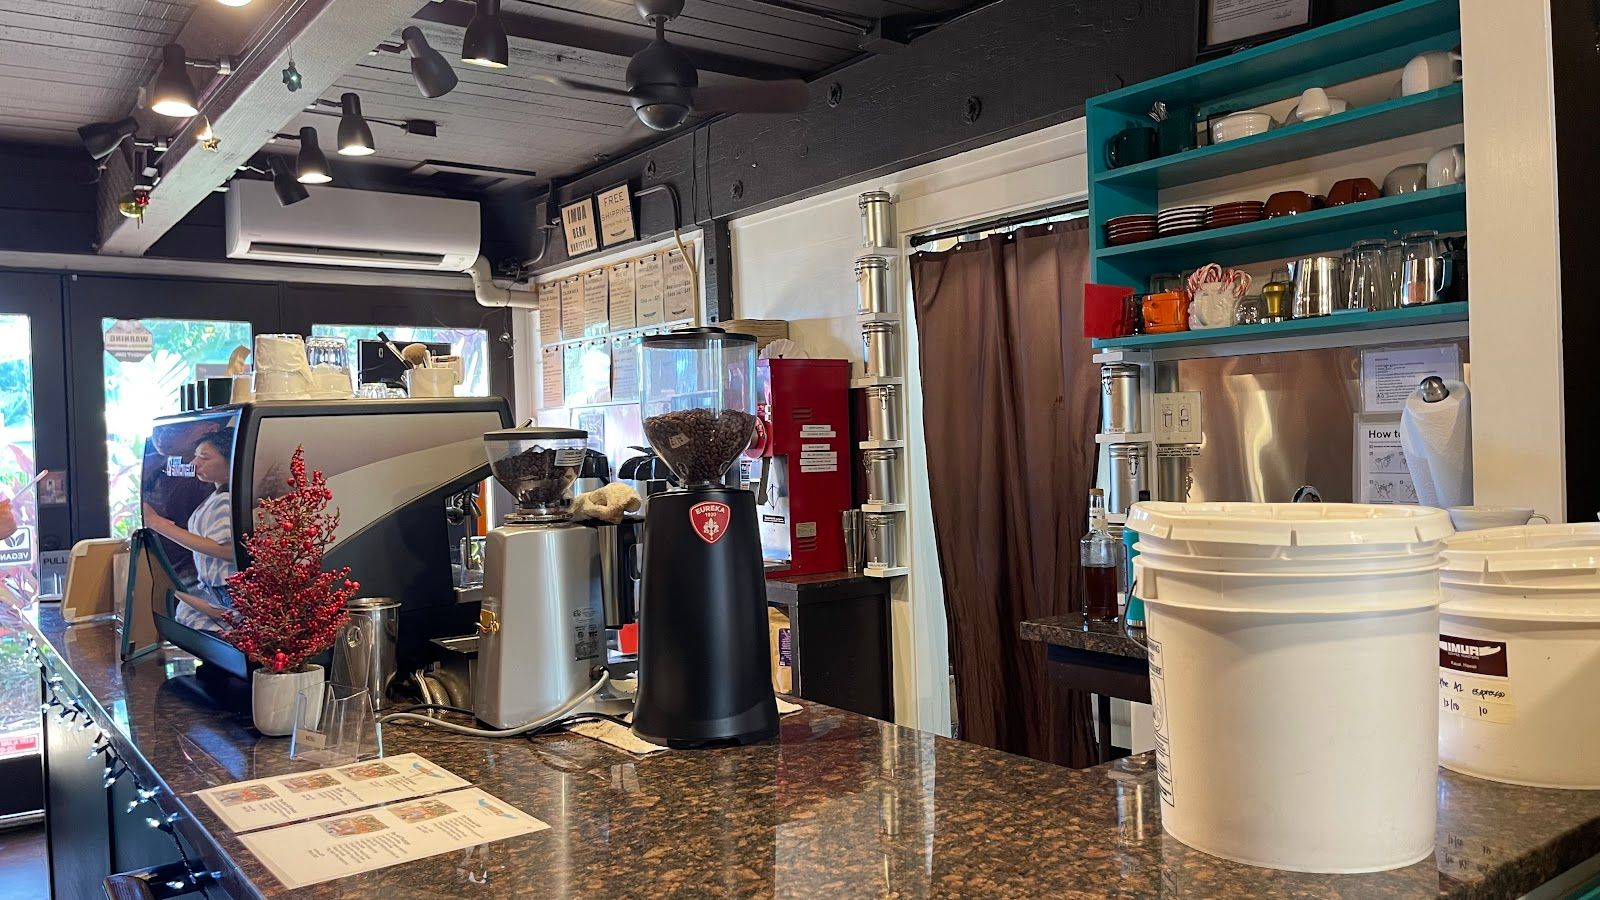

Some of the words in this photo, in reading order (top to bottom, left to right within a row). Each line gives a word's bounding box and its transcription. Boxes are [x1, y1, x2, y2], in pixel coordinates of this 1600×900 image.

[604, 191, 624, 206] FREE
[567, 205, 587, 224] IMUA
[601, 205, 631, 221] SHIPPING
[1368, 430, 1391, 438] How
[695, 504, 725, 515] EUREKA
[43, 556, 68, 565] PULL
[1448, 643, 1479, 656] IMUA
[1472, 688, 1506, 699] espresso
[1479, 705, 1488, 716] 10
